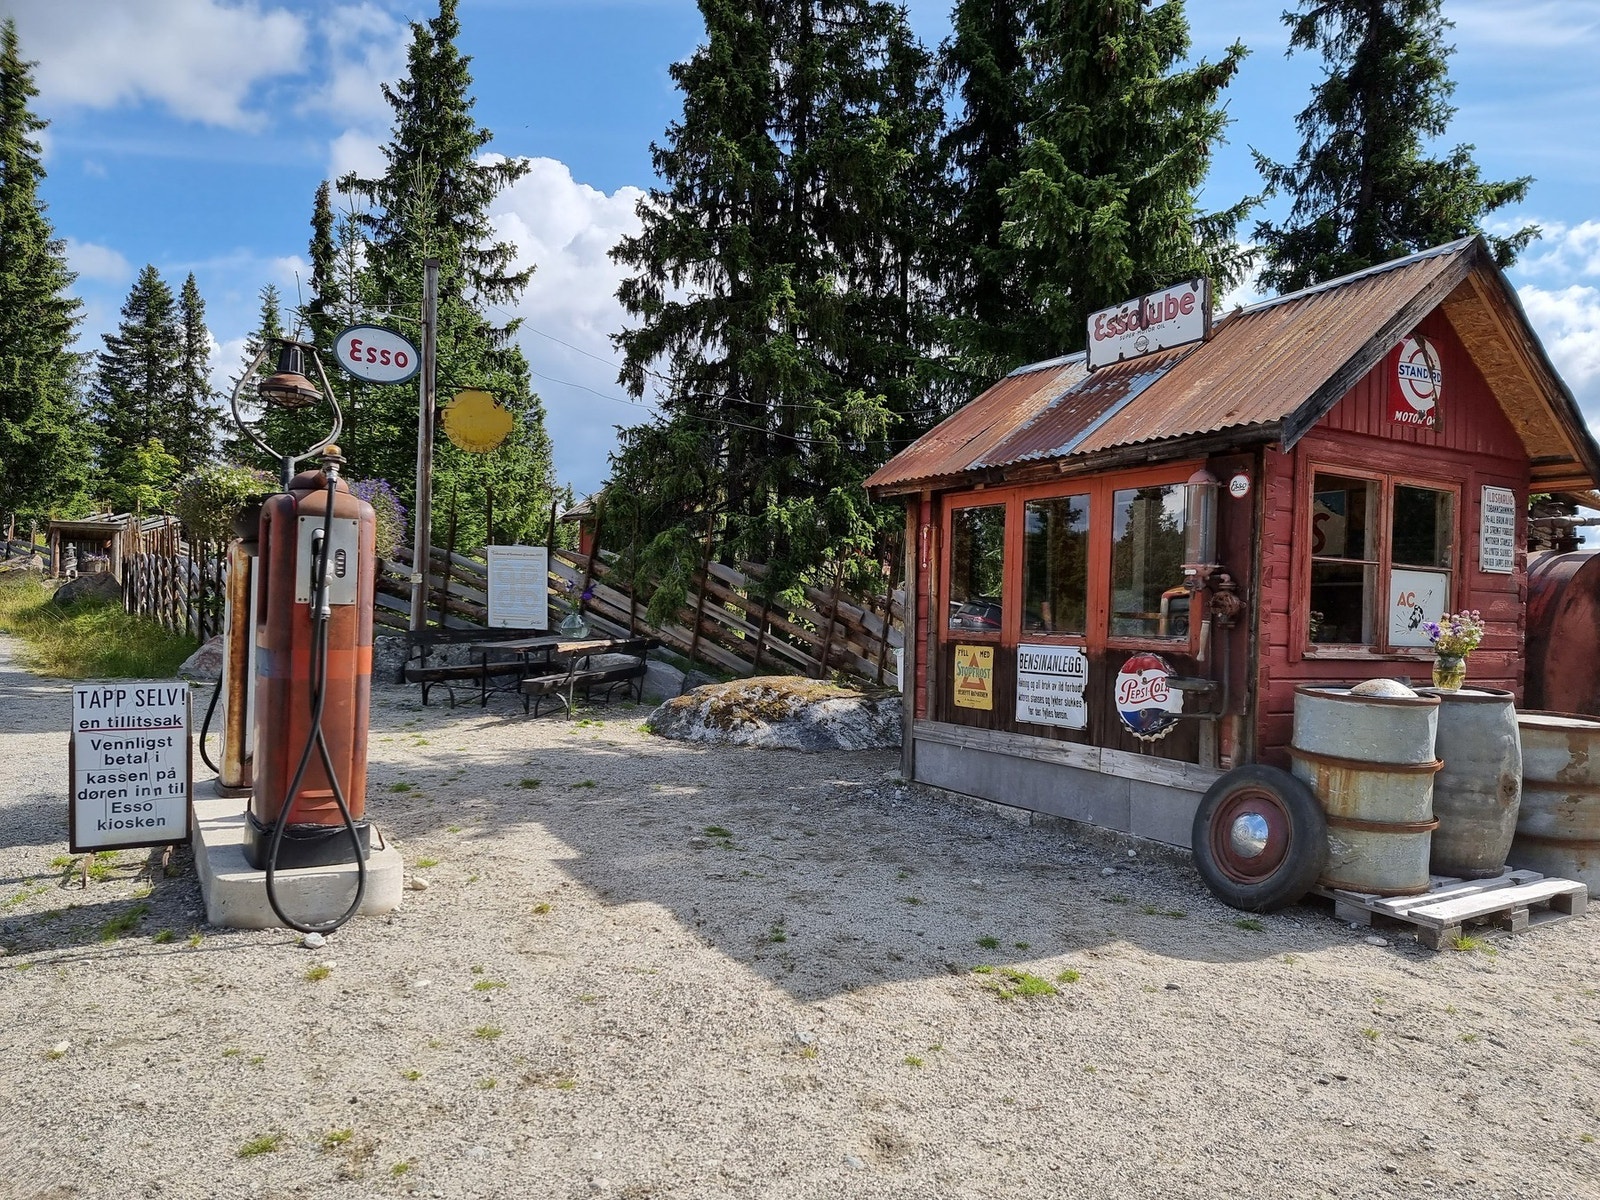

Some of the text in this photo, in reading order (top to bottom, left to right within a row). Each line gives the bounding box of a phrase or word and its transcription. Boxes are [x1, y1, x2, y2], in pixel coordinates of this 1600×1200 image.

[1399, 364, 1442, 383] STANDRD
[1397, 591, 1416, 608] AC
[980, 650, 991, 659] MED
[1030, 681, 1035, 691] og
[1041, 680, 1051, 691] bruk
[1051, 683, 1057, 691] av
[78, 688, 185, 709] TAPP SELV!
[1045, 697, 1051, 707] og
[1051, 695, 1064, 708] lykter
[1064, 698, 1083, 709] slukkes
[79, 714, 183, 729] en tillitssak
[91, 736, 173, 751] Vennligst
[104, 751, 159, 766] betal i
[87, 766, 176, 785] kassen på
[77, 782, 184, 801] døren inn til
[111, 802, 153, 814] Esso
[97, 816, 166, 831] kiosken
